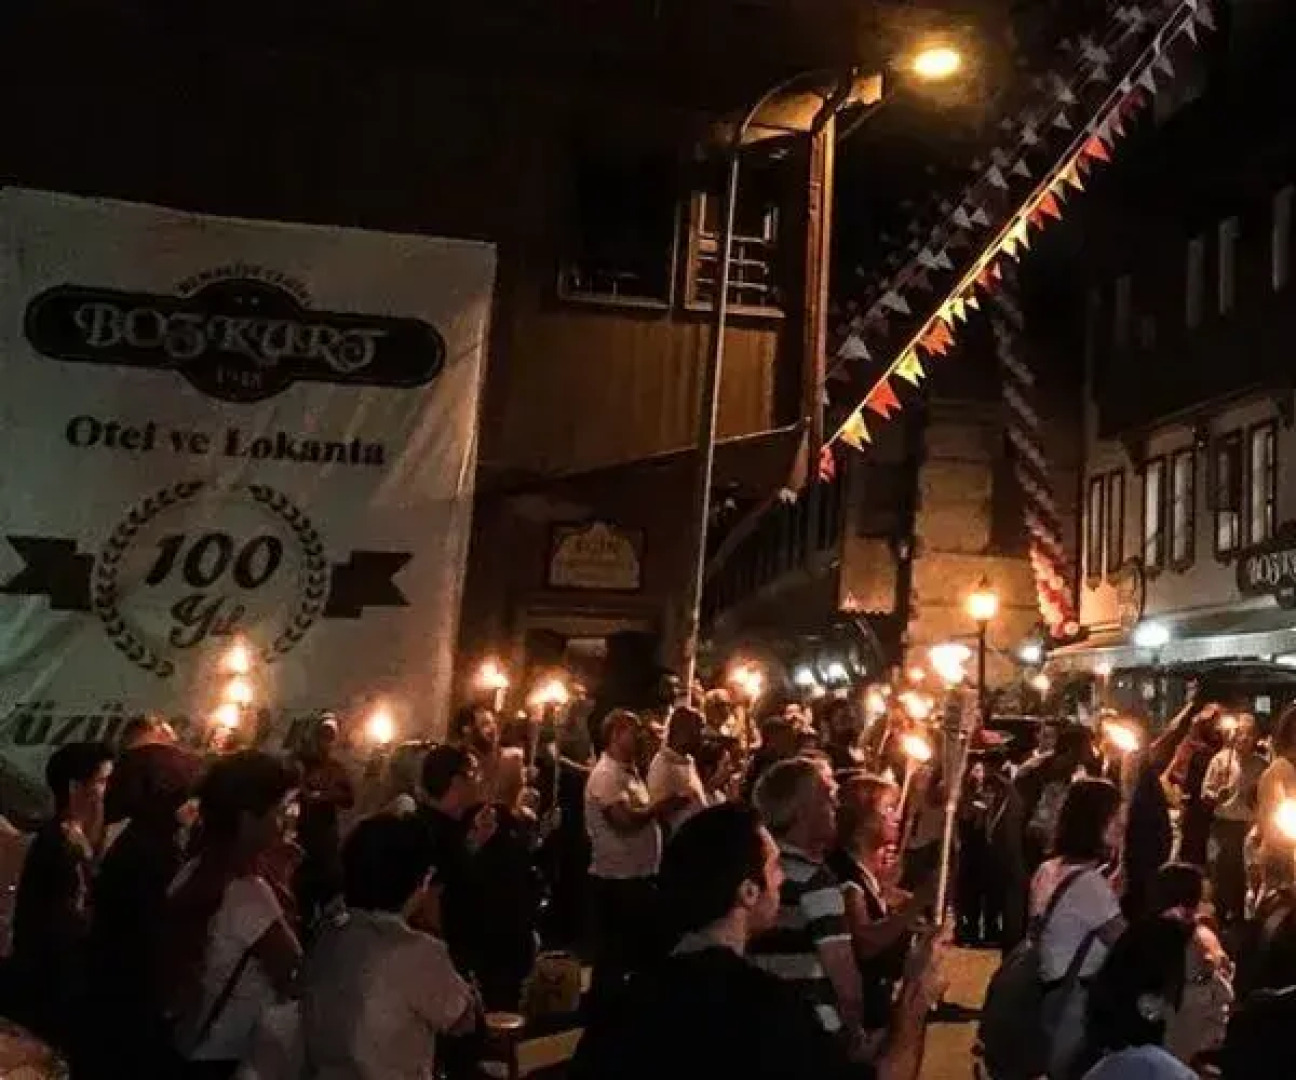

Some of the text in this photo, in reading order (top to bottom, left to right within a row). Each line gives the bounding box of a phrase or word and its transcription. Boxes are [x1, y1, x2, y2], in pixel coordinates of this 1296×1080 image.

[73, 301, 389, 374] BOZKURT
[66, 415, 385, 465] Otel ve Lokanta
[145, 532, 284, 589] 100
